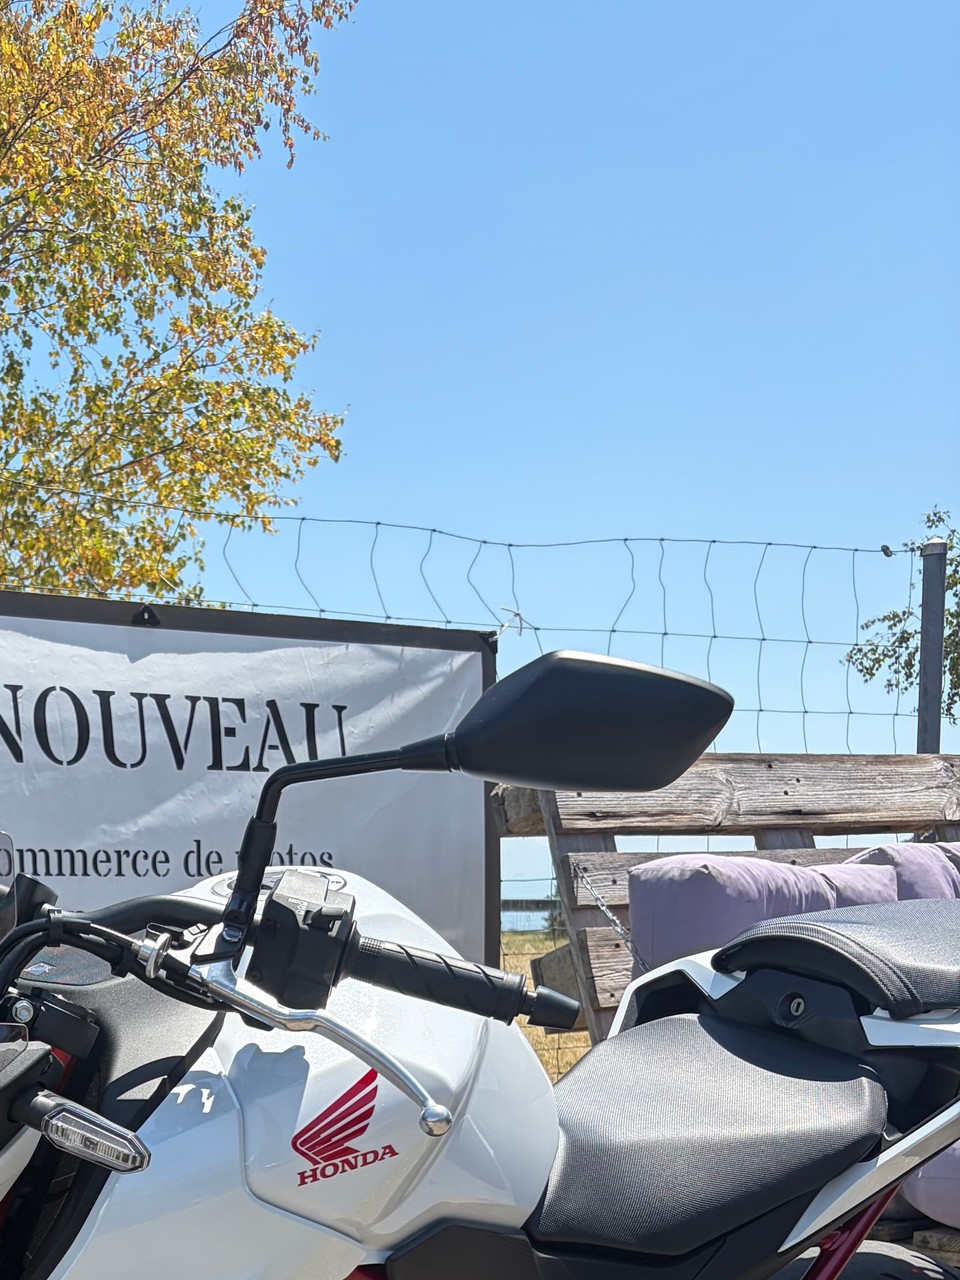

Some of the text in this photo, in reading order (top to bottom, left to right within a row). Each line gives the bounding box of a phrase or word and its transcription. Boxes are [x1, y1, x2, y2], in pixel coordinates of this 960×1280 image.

[183, 839, 224, 878] de
[235, 843, 334, 868] otos
[297, 1144, 400, 1187] HONDA
